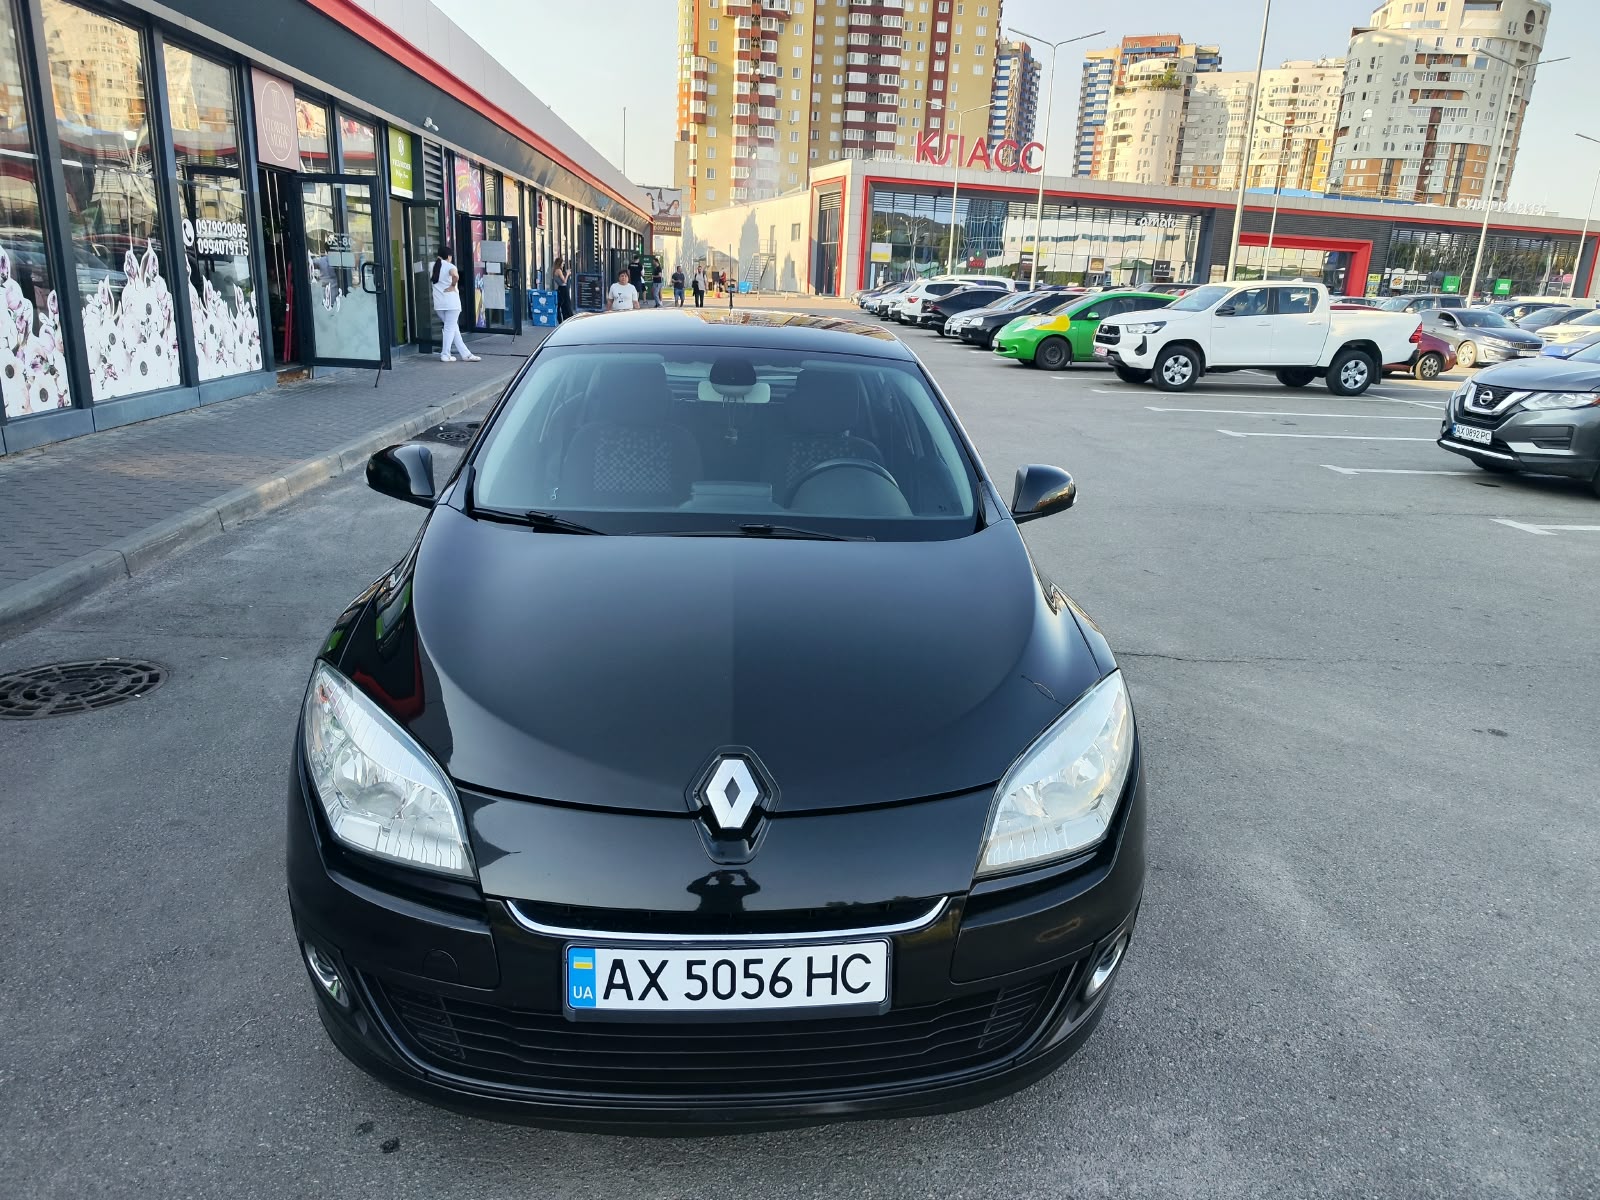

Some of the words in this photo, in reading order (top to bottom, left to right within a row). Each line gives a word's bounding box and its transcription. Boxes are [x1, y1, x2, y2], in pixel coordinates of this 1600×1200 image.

[915, 130, 1044, 173] КЛАСС
[196, 218, 248, 239] 0979920895
[197, 238, 249, 256] 0994079715
[603, 958, 669, 1001] AX
[684, 957, 793, 1001] 5056
[806, 953, 871, 997] HC
[573, 985, 593, 999] UA
